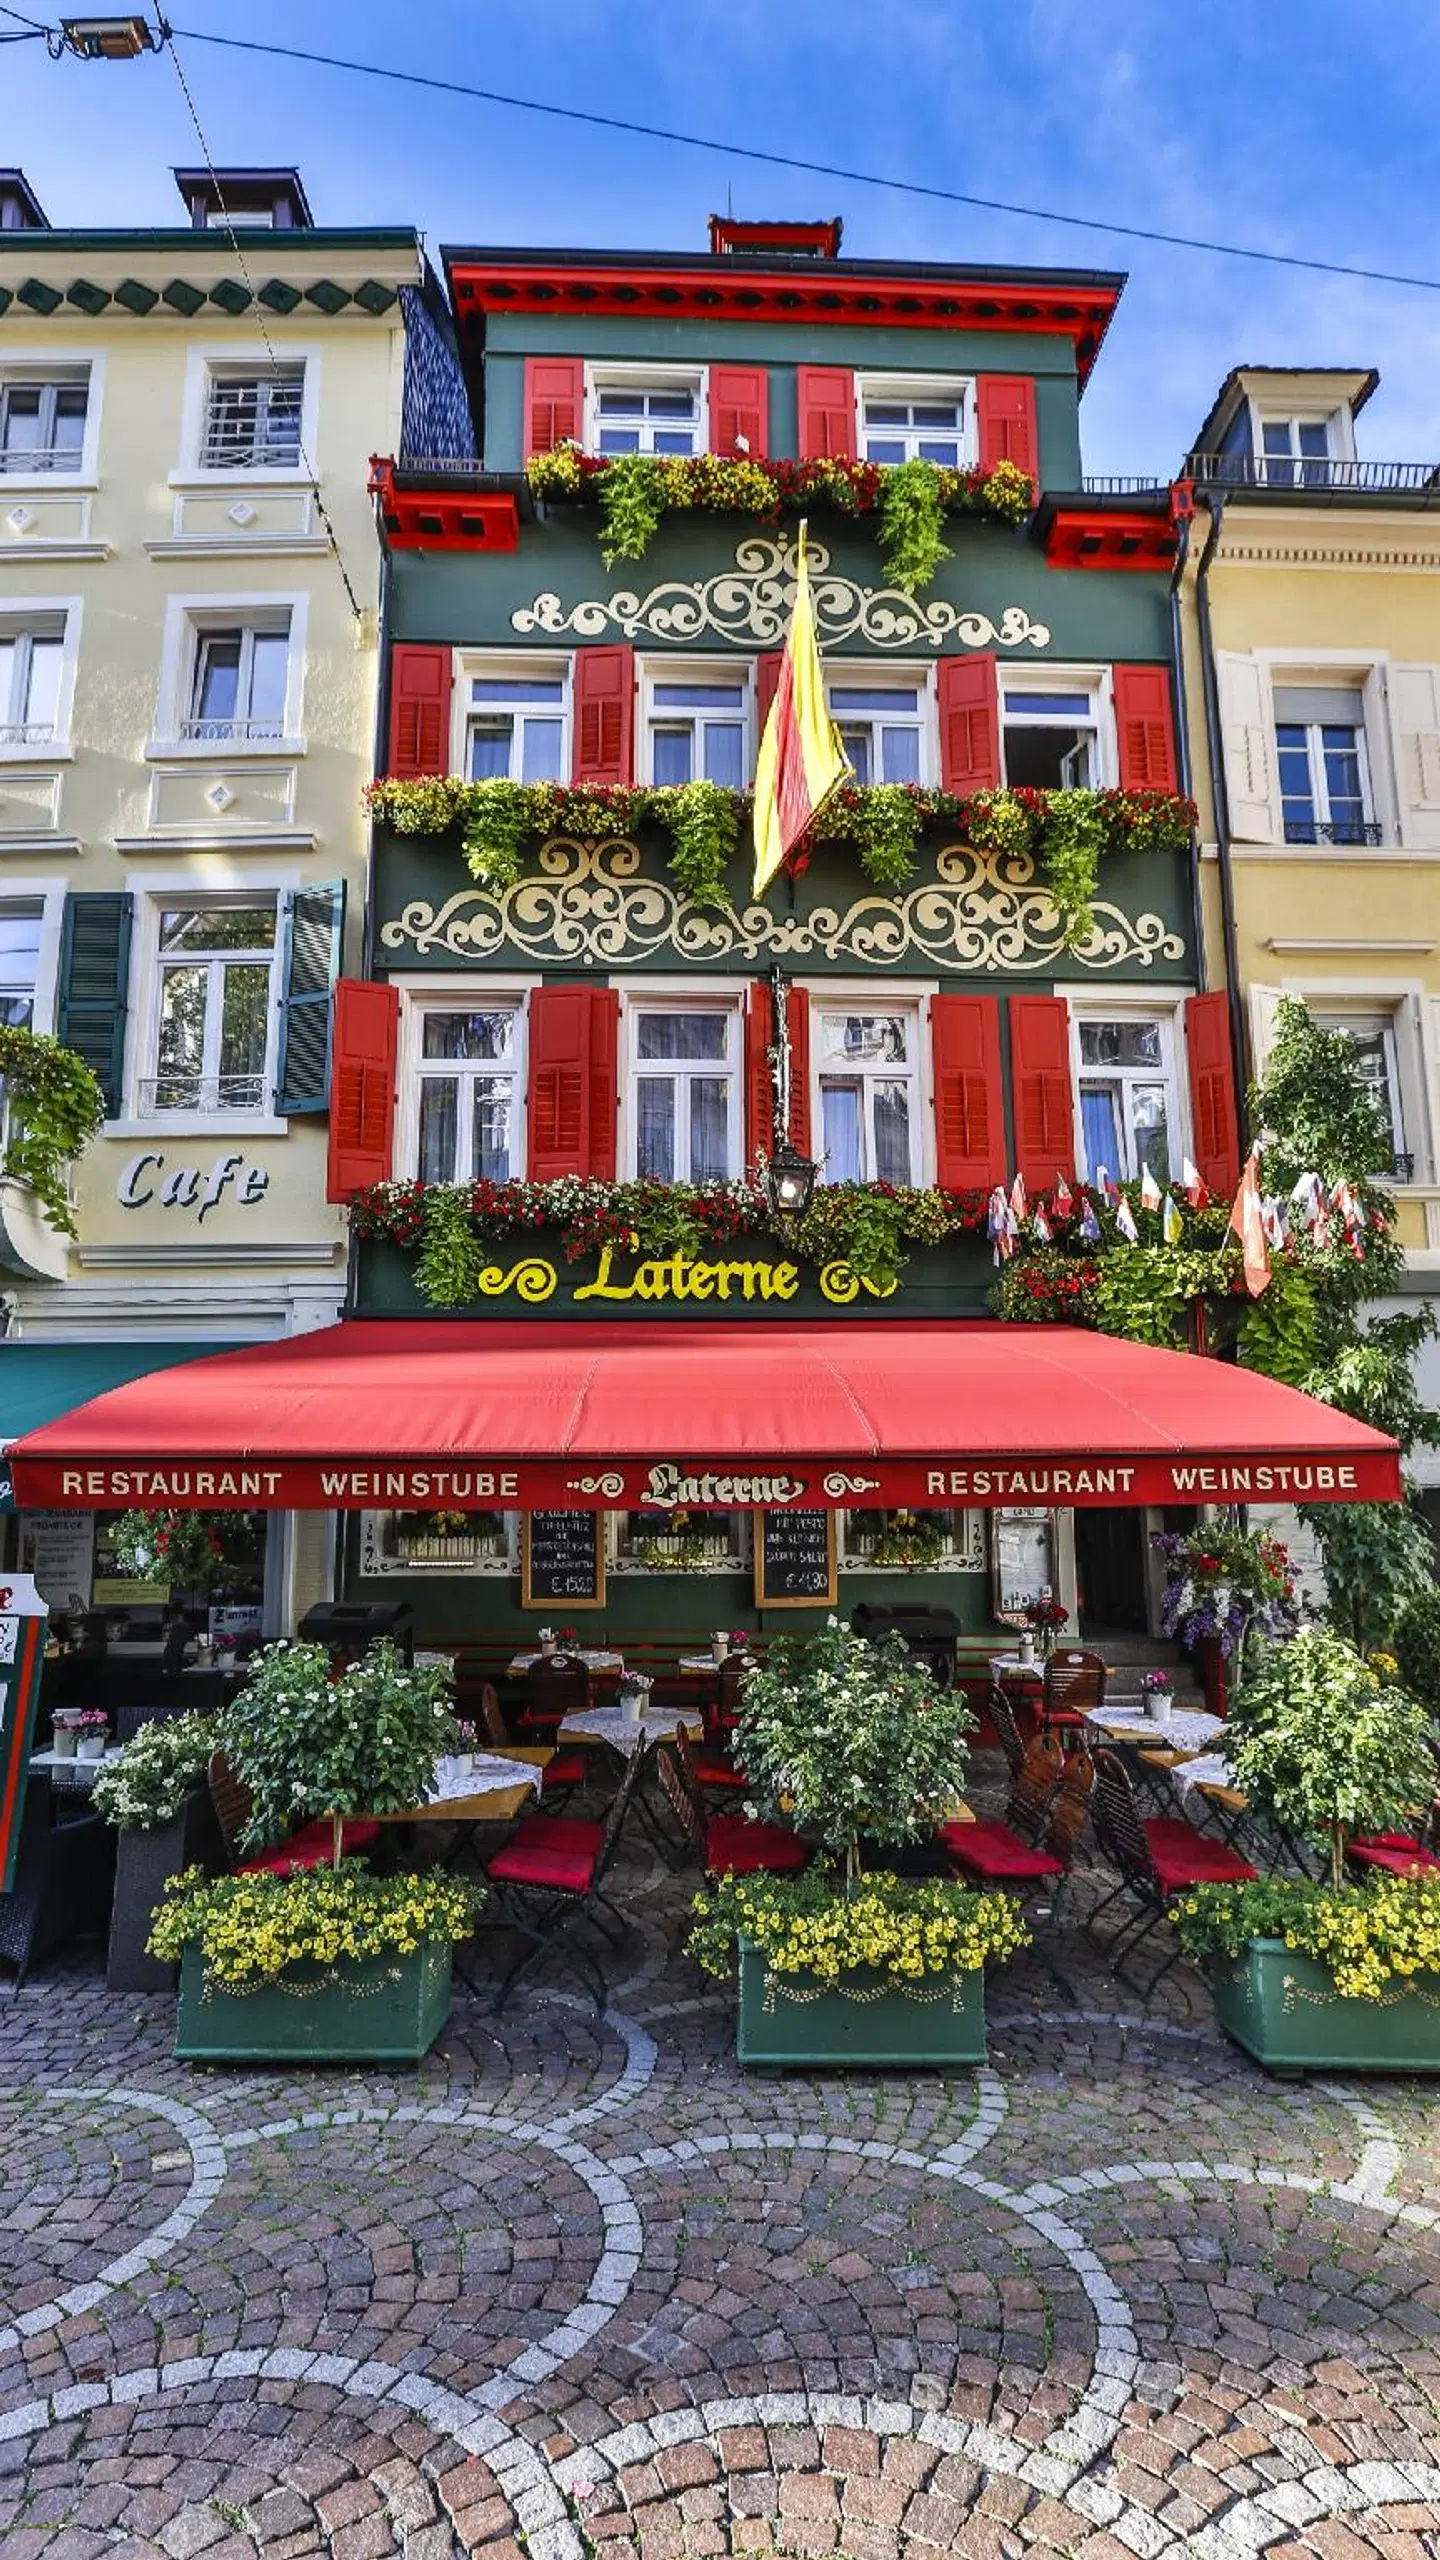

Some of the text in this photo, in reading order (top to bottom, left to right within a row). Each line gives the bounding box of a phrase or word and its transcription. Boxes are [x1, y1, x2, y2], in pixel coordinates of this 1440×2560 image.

[117, 1153, 269, 1223] Cafe
[573, 1232, 799, 1301] Laterne
[62, 1463, 1358, 1507] RESTAURANT WEINSTUBE Laterne RESTAURANT WEINSTUBE
